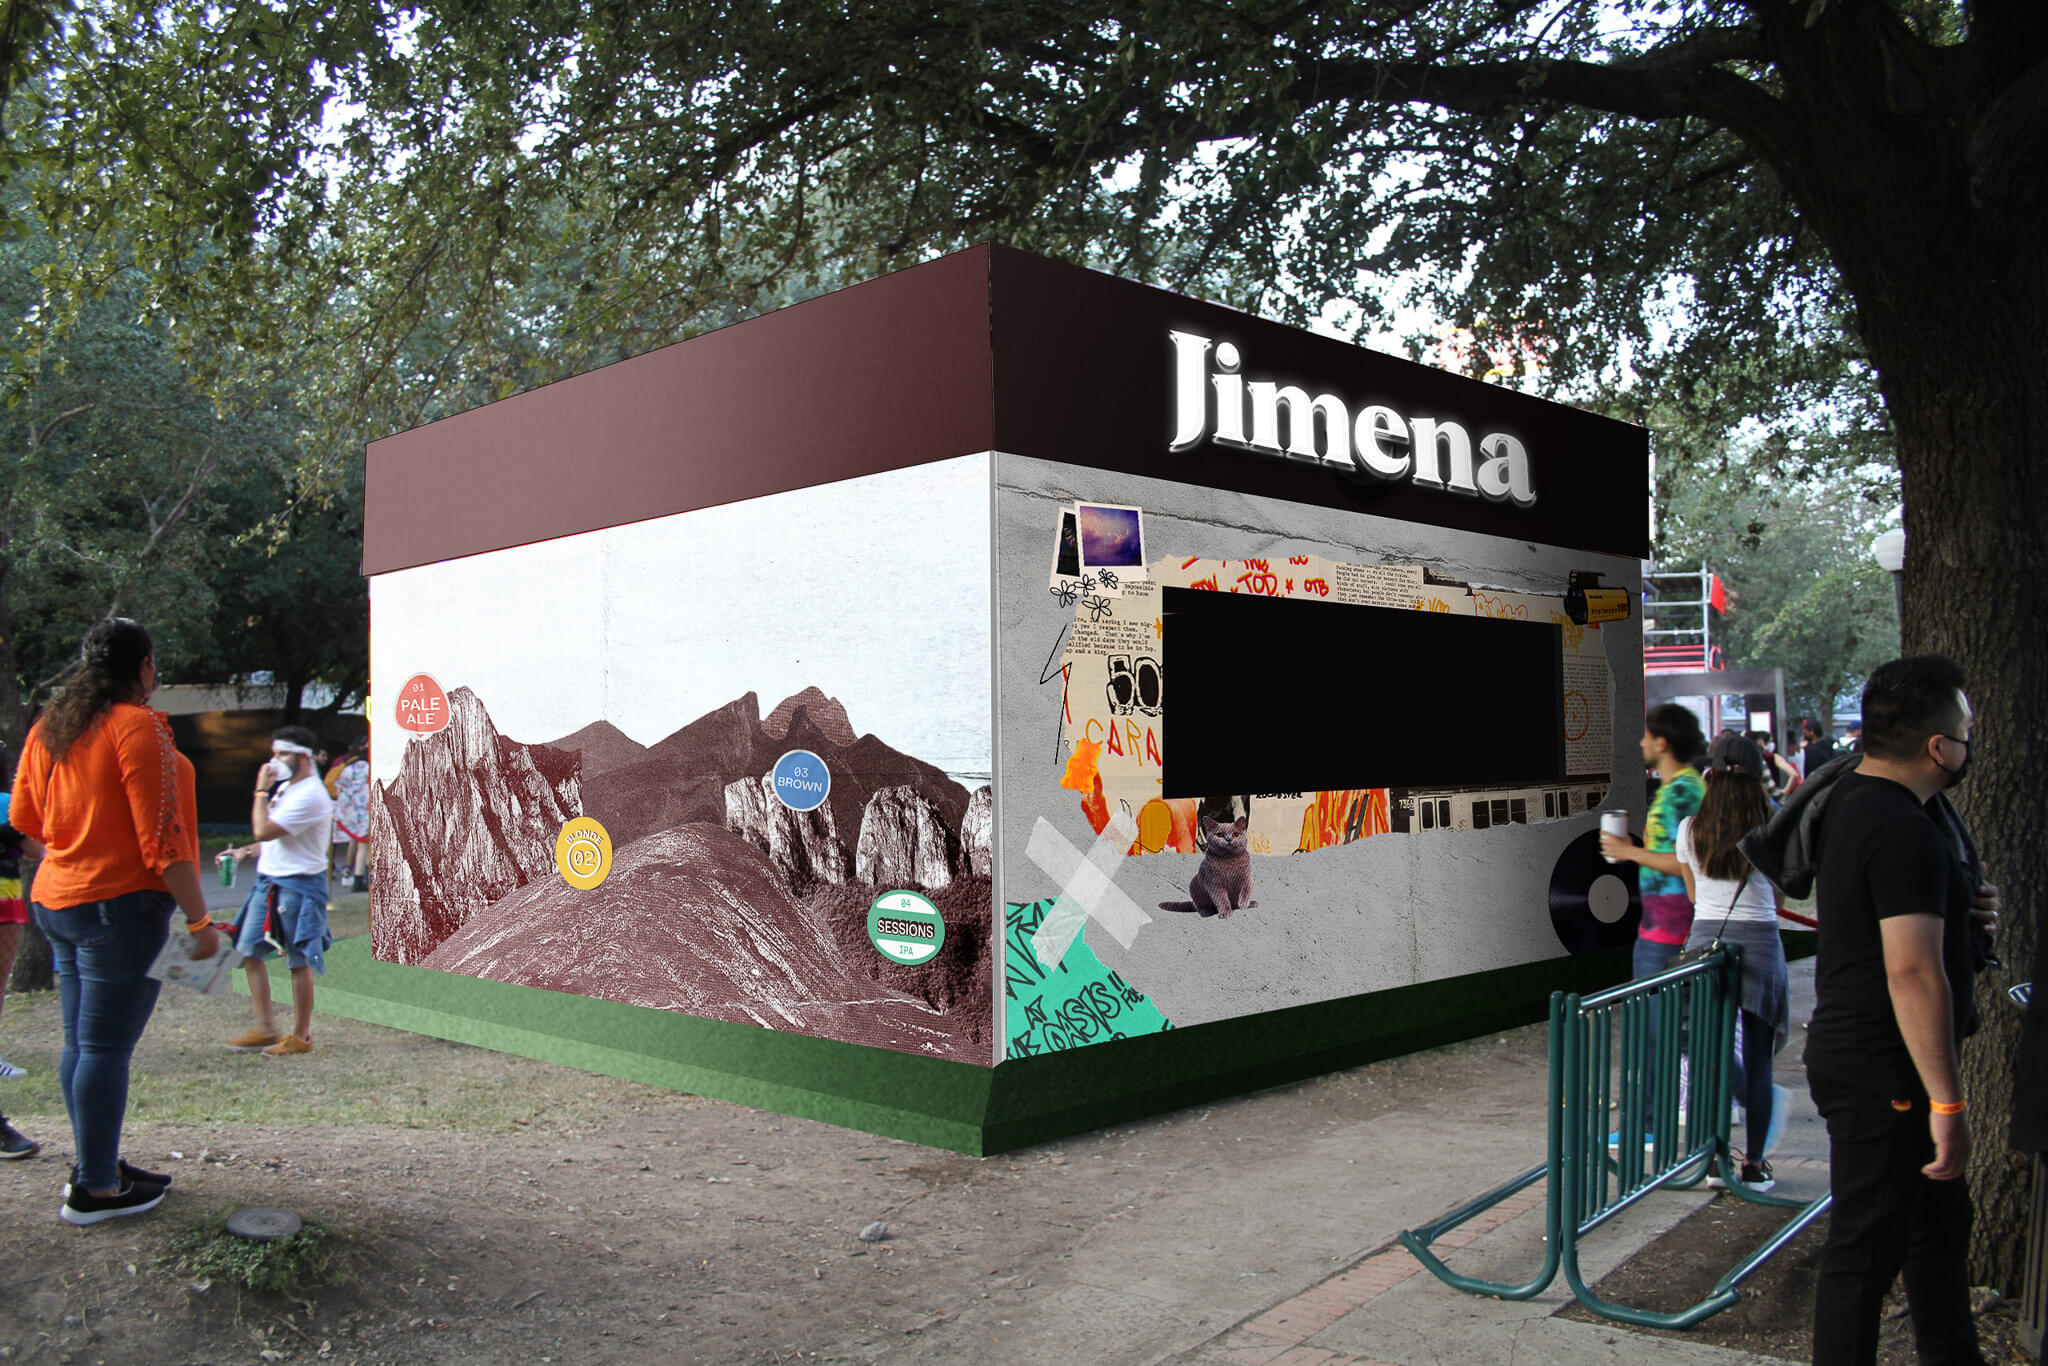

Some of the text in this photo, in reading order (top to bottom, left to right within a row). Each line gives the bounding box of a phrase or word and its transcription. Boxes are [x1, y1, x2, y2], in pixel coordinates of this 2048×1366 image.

[1168, 329, 1537, 508] Jimena
[413, 683, 424, 692] 01
[401, 697, 441, 711] PALE
[406, 713, 436, 725] ALE
[794, 766, 809, 778] 03
[777, 776, 823, 793] BROWN
[565, 828, 605, 845] BLONDE
[574, 850, 596, 866] 02
[901, 898, 911, 908] 04
[877, 918, 935, 940] SESSIONS
[899, 944, 914, 956] IPA
